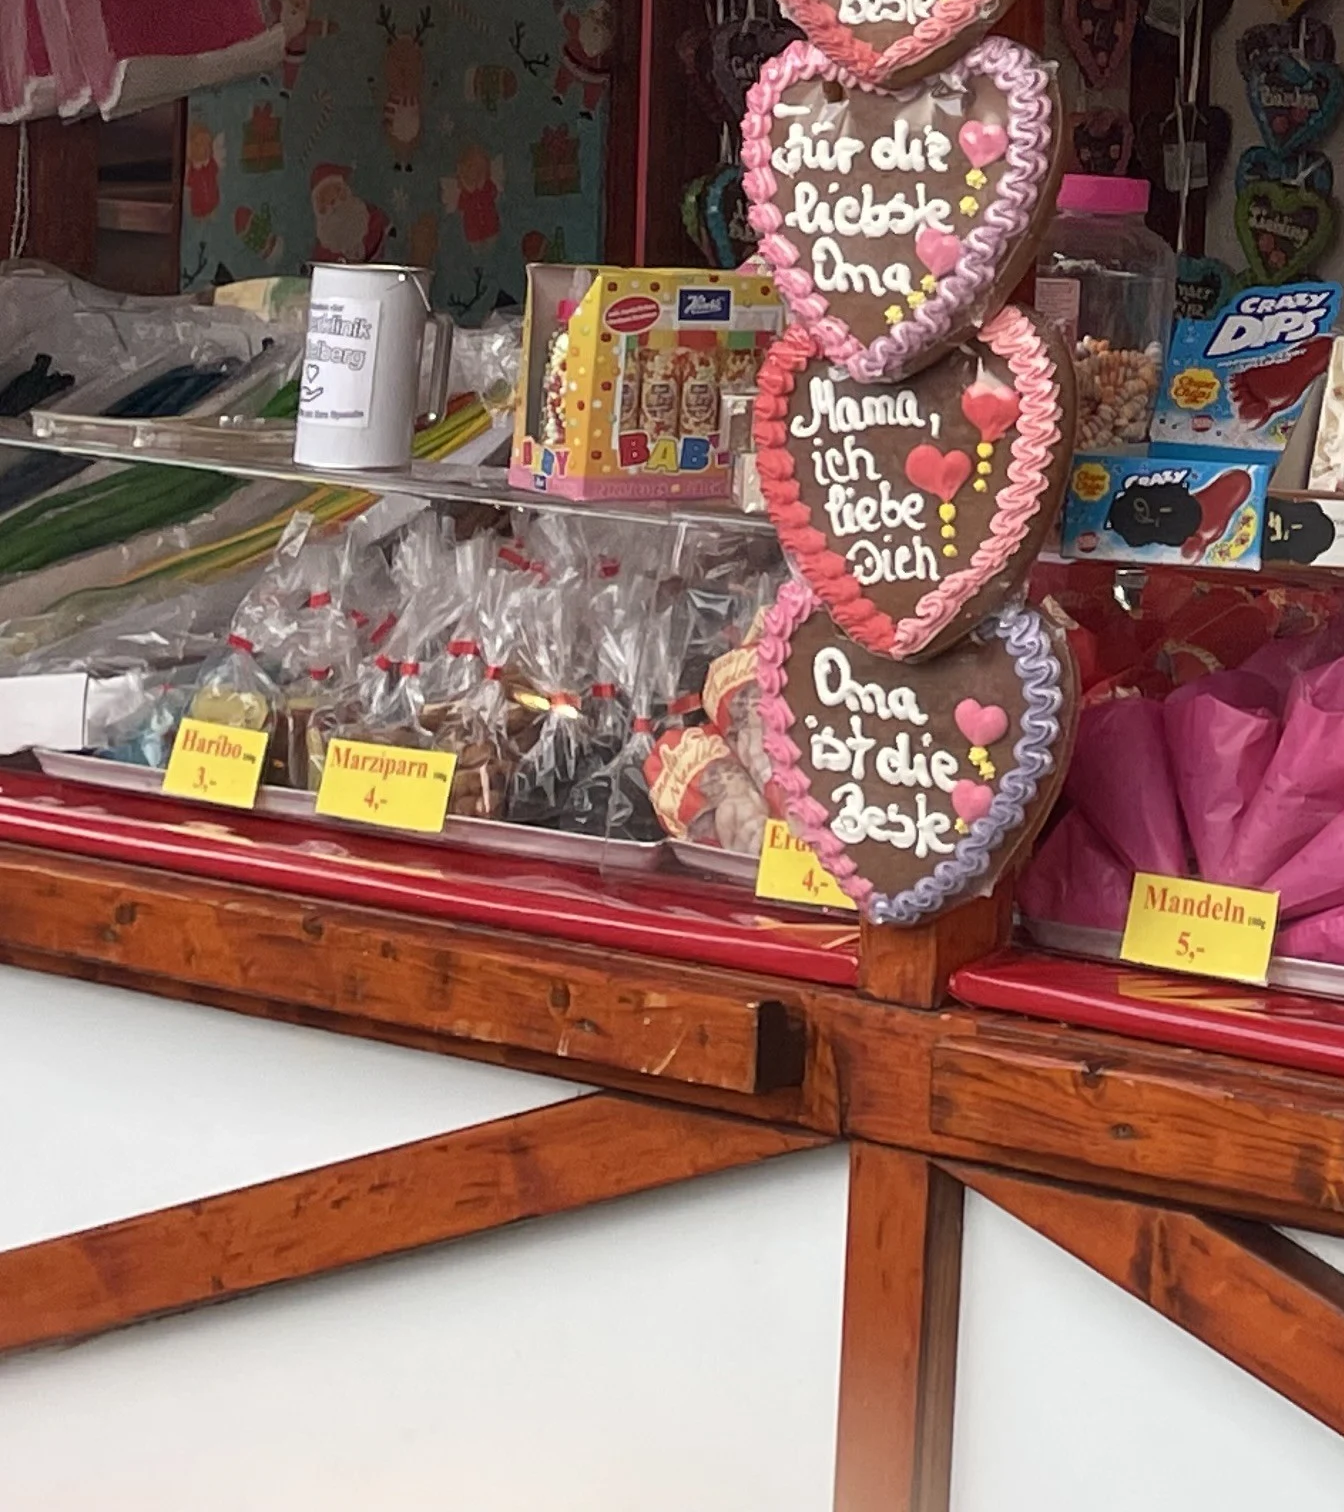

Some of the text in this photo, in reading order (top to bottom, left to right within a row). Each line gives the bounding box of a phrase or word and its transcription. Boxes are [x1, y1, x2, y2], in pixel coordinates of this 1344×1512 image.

[871, 120, 952, 172] die
[785, 182, 955, 240] liebste
[811, 236, 913, 296] Oma
[1240, 291, 1332, 314] CRAZY
[1206, 308, 1329, 360] DIPS
[790, 377, 941, 438] Mama,
[811, 436, 882, 486] ich
[846, 535, 941, 586] Dich
[813, 646, 929, 726] Oma
[181, 728, 243, 760] Haribo
[804, 715, 959, 793] ist die
[193, 766, 218, 792] 3,-
[363, 785, 388, 813] 4,-
[831, 782, 955, 858] Beste
[802, 868, 829, 896] 4,-
[1144, 884, 1246, 926] Mandeln
[1175, 931, 1206, 963] 5,-
